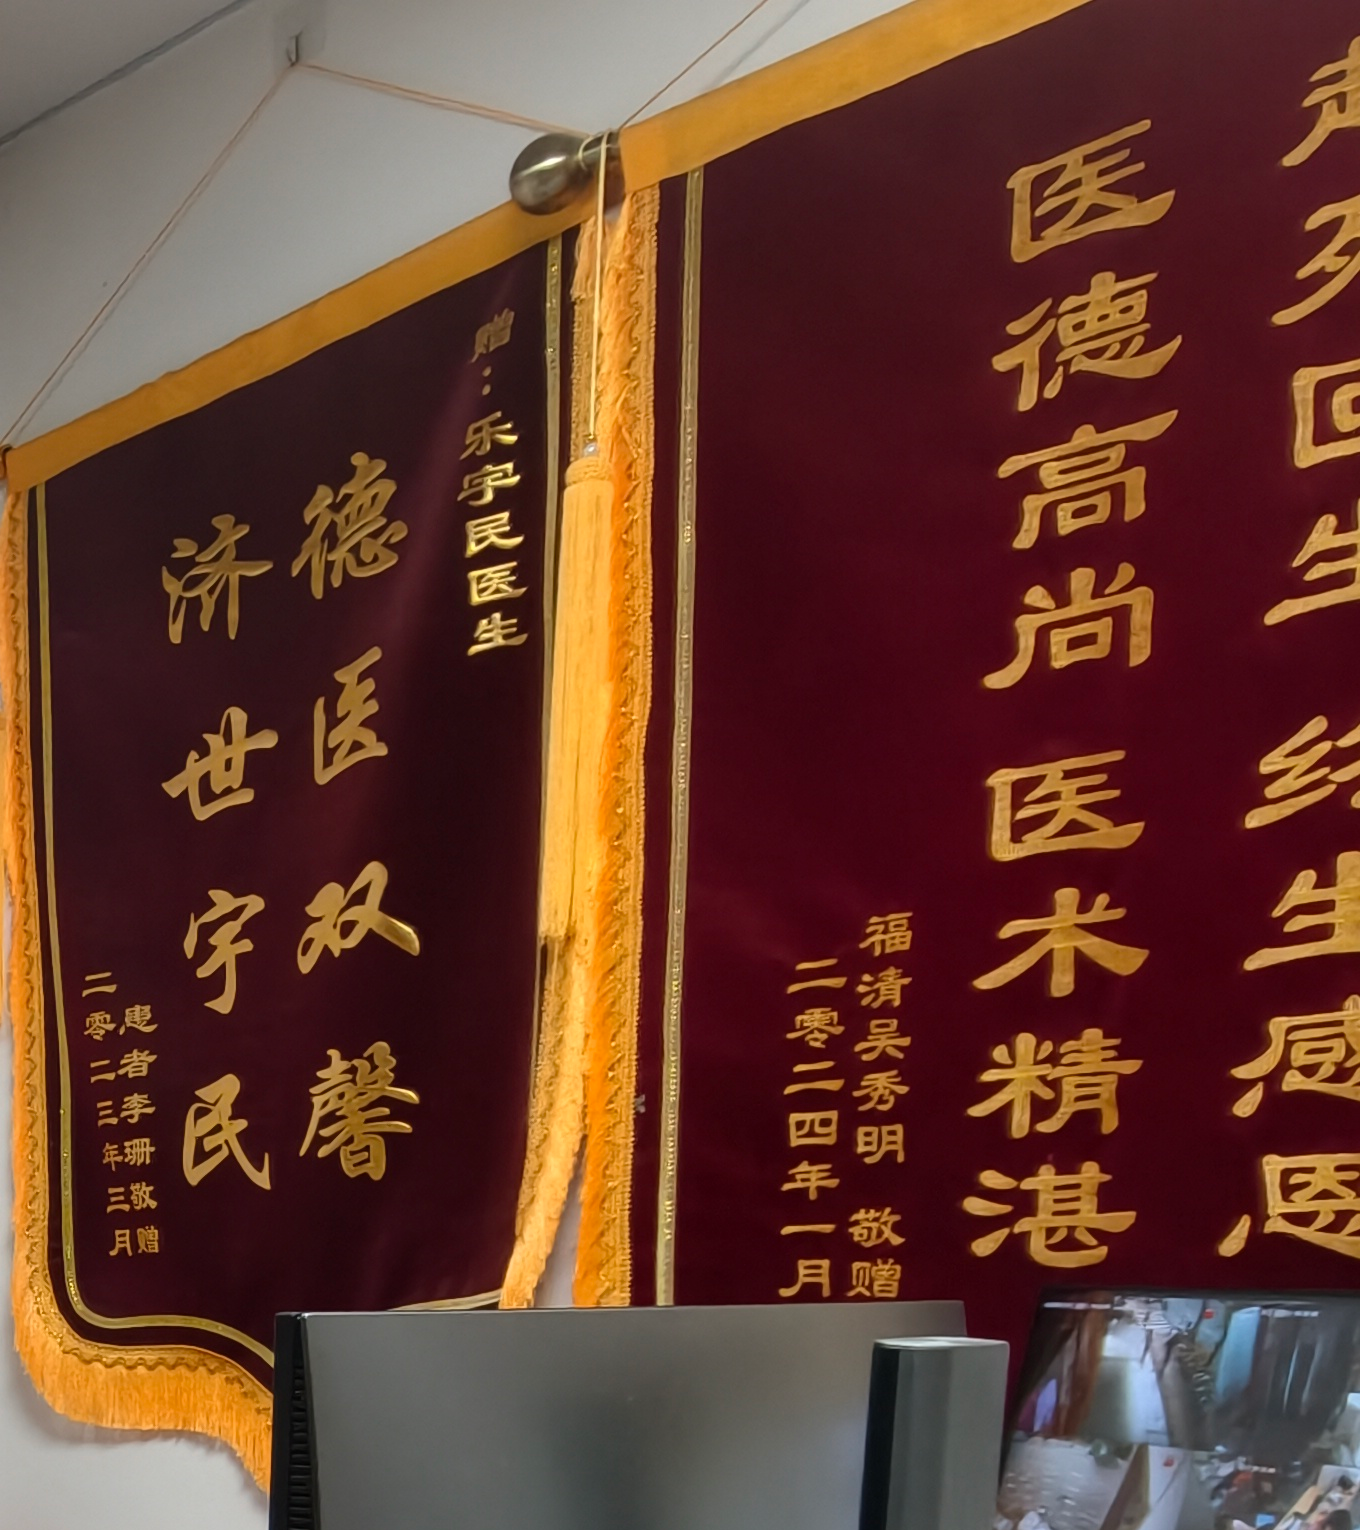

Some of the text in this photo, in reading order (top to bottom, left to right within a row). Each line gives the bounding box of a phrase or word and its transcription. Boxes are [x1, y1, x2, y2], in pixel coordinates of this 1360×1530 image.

[161, 514, 278, 1190] 济世宇民
[292, 451, 420, 1182] 德医双馨
[962, 119, 1182, 1268] 医德高尚 医术精湛
[779, 958, 847, 1298] 二零二四年一月
[844, 1206, 907, 1299] 敬赠
